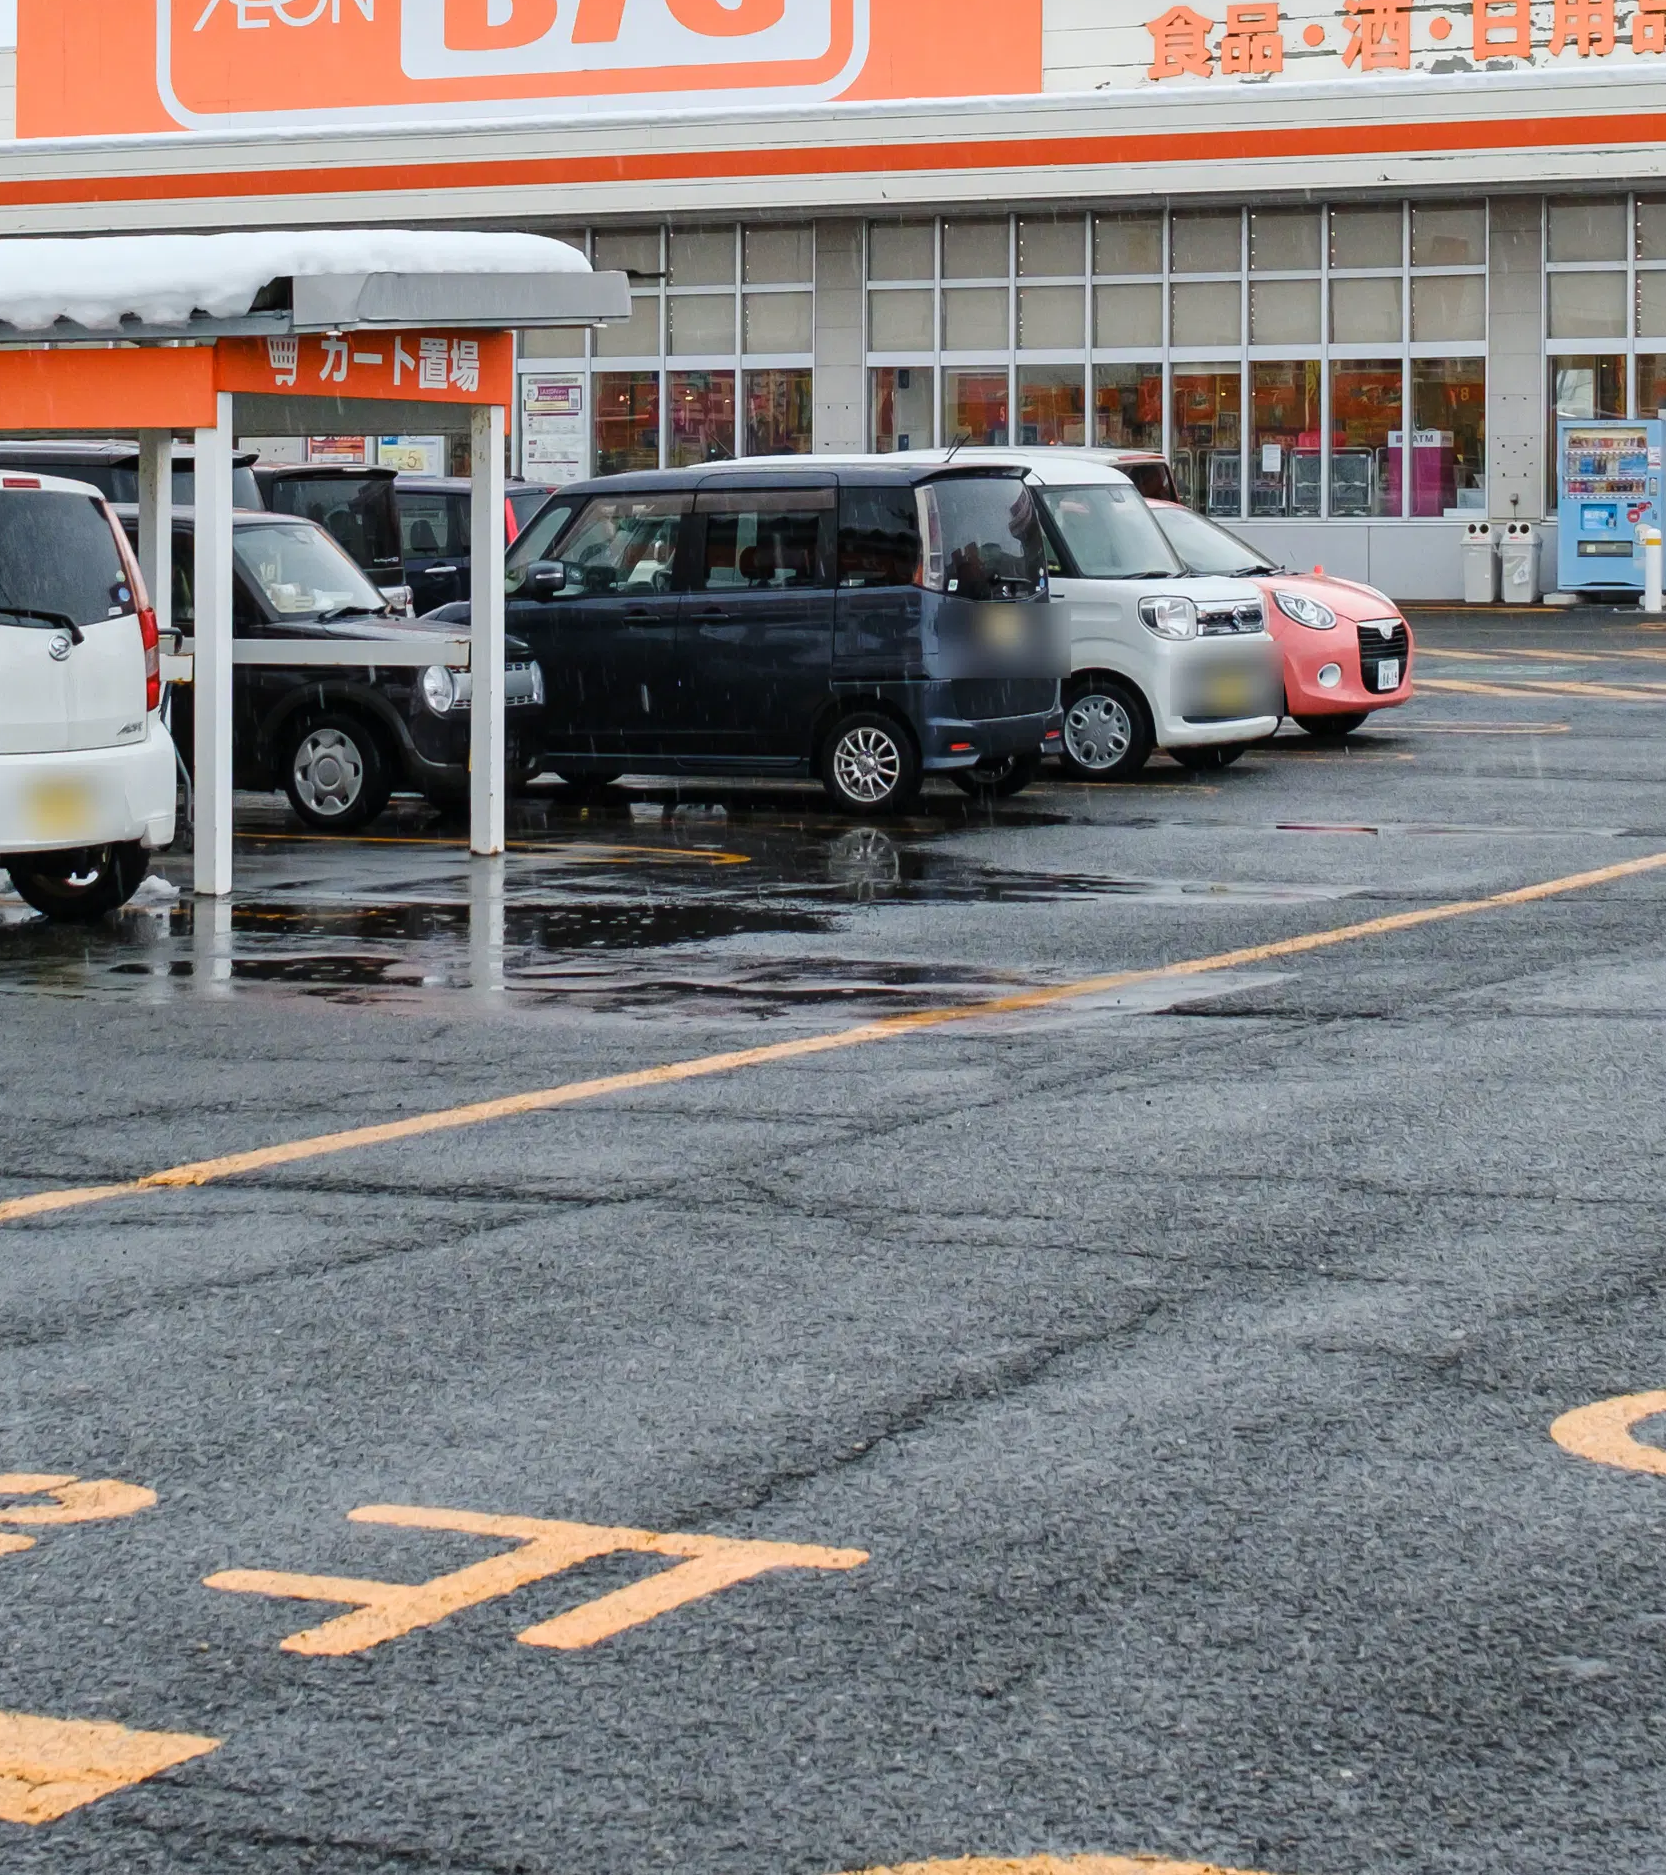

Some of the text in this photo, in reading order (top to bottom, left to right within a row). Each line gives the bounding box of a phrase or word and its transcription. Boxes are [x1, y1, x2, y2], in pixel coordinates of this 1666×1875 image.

[320, 336, 479, 392] カート置場
